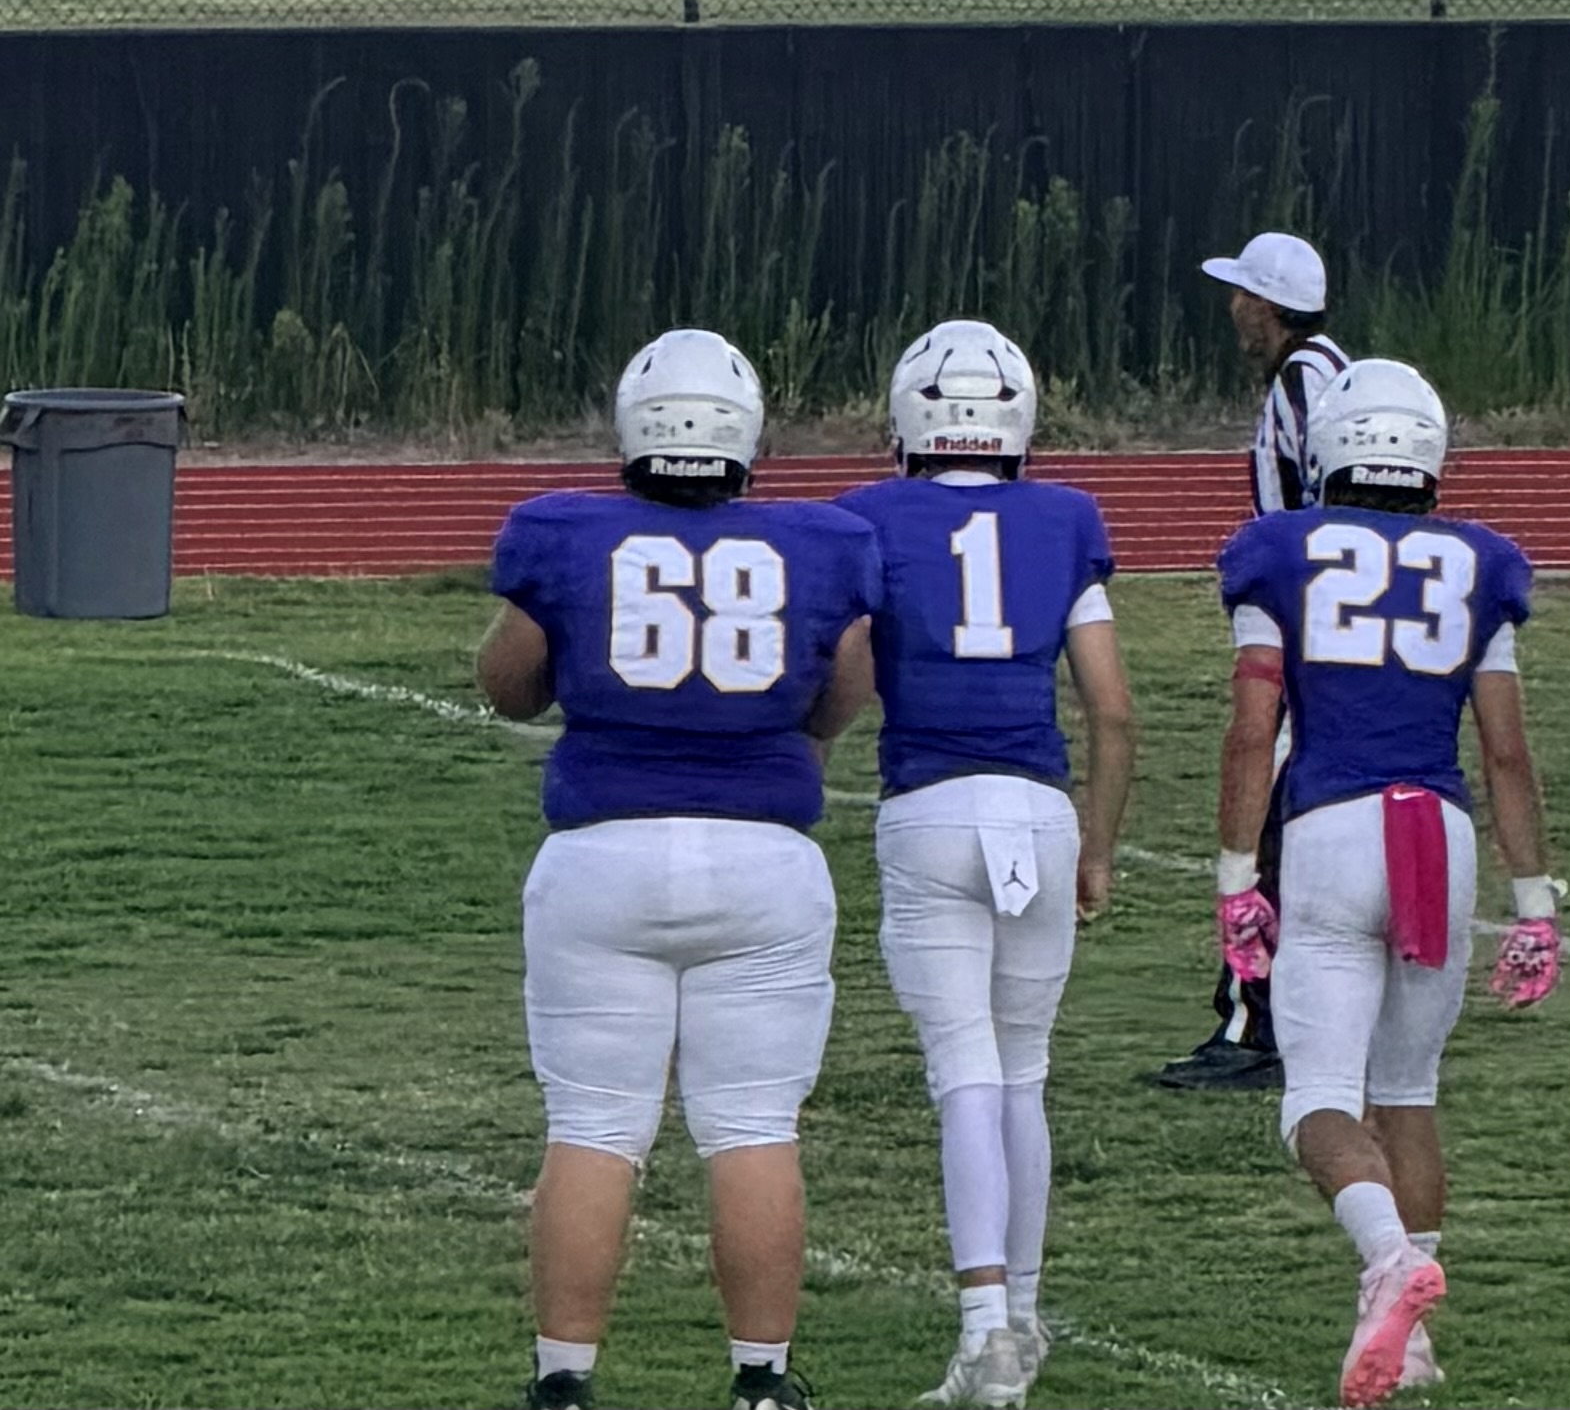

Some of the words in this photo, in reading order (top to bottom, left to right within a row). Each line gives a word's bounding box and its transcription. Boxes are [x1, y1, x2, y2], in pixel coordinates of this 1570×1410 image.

[651, 456, 726, 477] Riddell
[934, 436, 1003, 451] Riddell
[1351, 466, 1424, 489] Riddell
[608, 535, 786, 694] 68
[950, 511, 1014, 660] 1
[1303, 523, 1477, 676] 23
